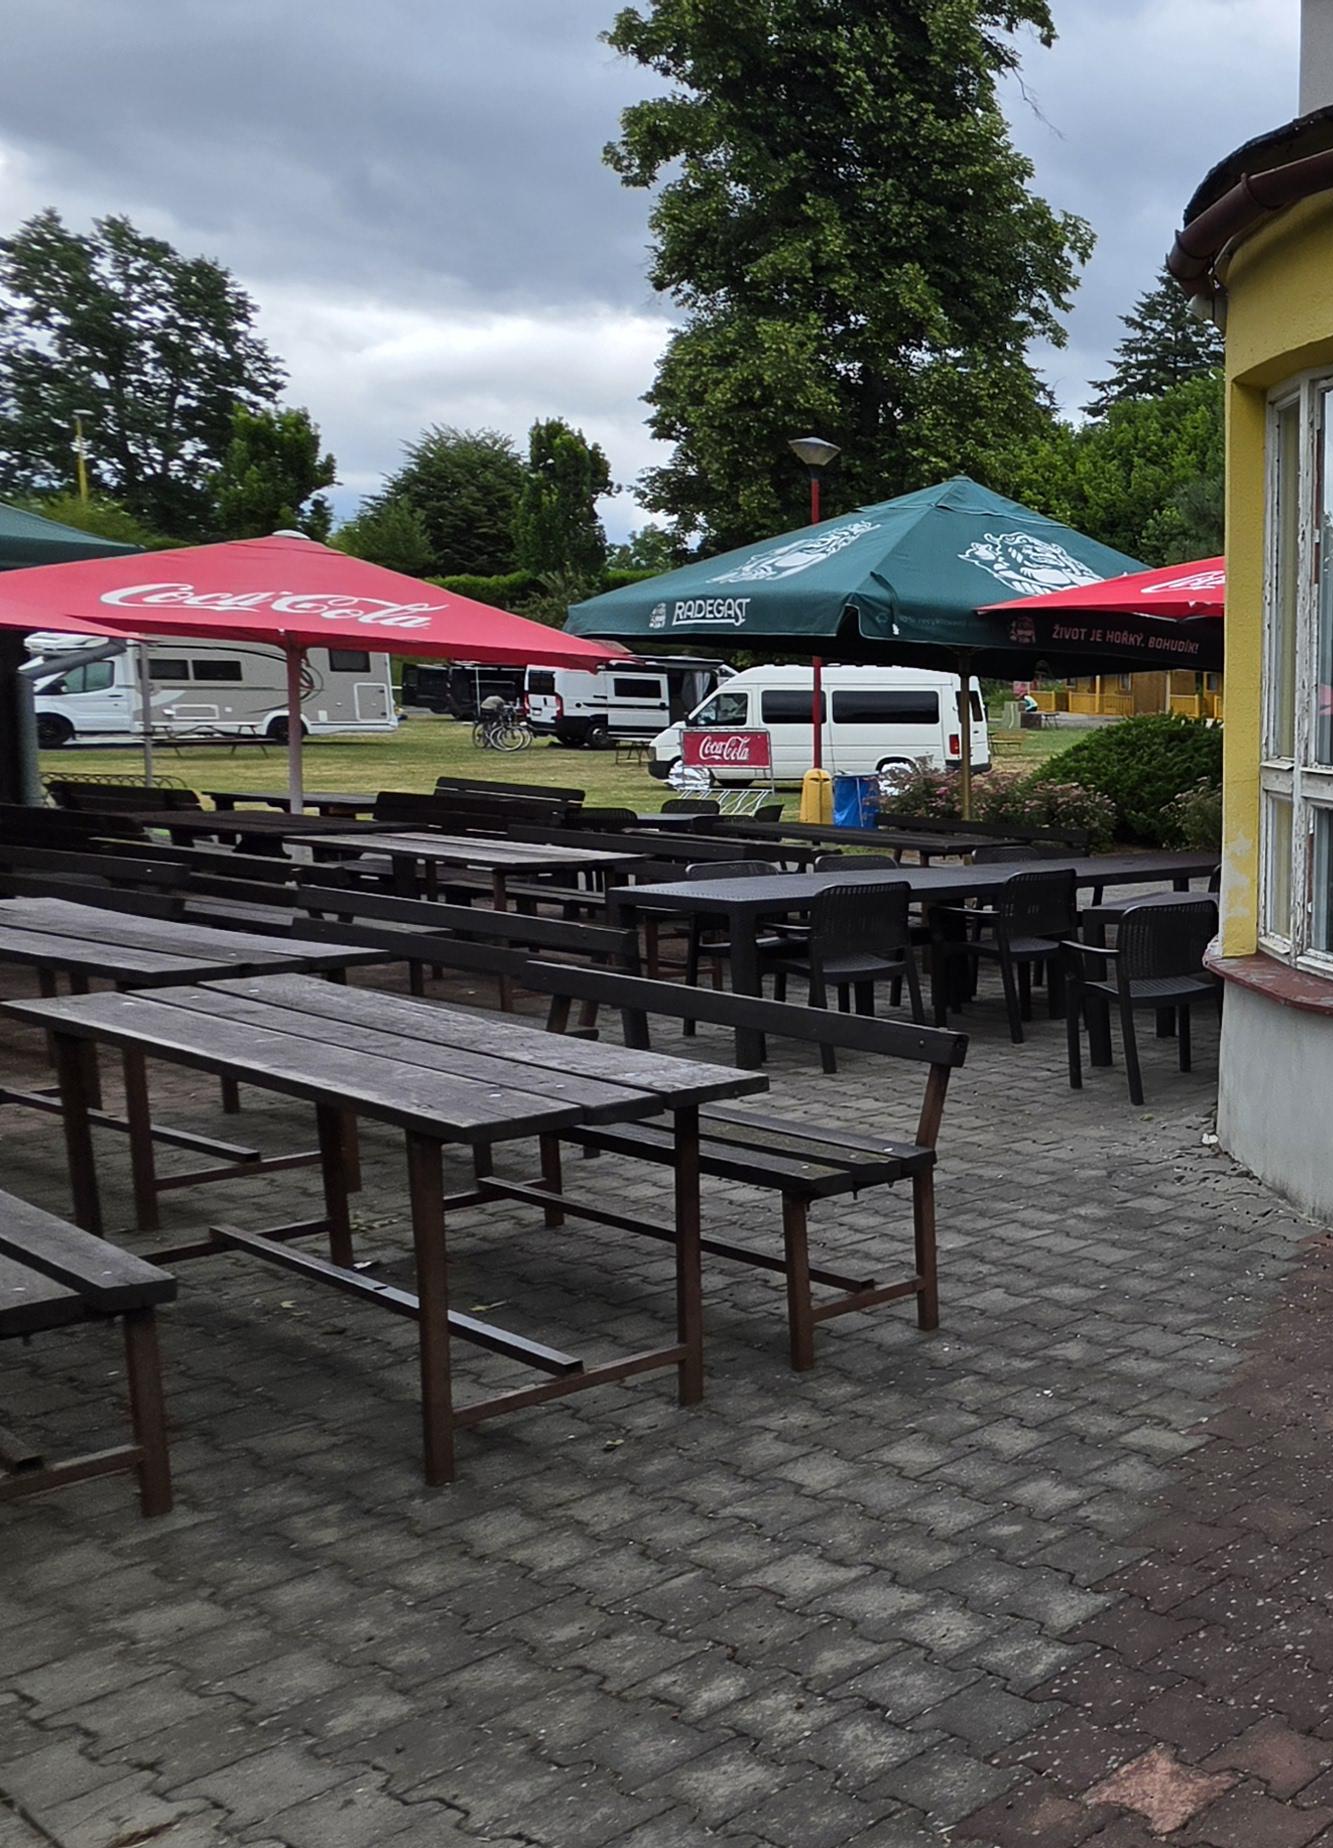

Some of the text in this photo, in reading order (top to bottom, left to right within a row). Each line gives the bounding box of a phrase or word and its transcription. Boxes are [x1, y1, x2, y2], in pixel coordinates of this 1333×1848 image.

[672, 598, 751, 627] RADEGAST
[1052, 623, 1087, 641] ŽIVOT
[1090, 629, 1103, 643] JE
